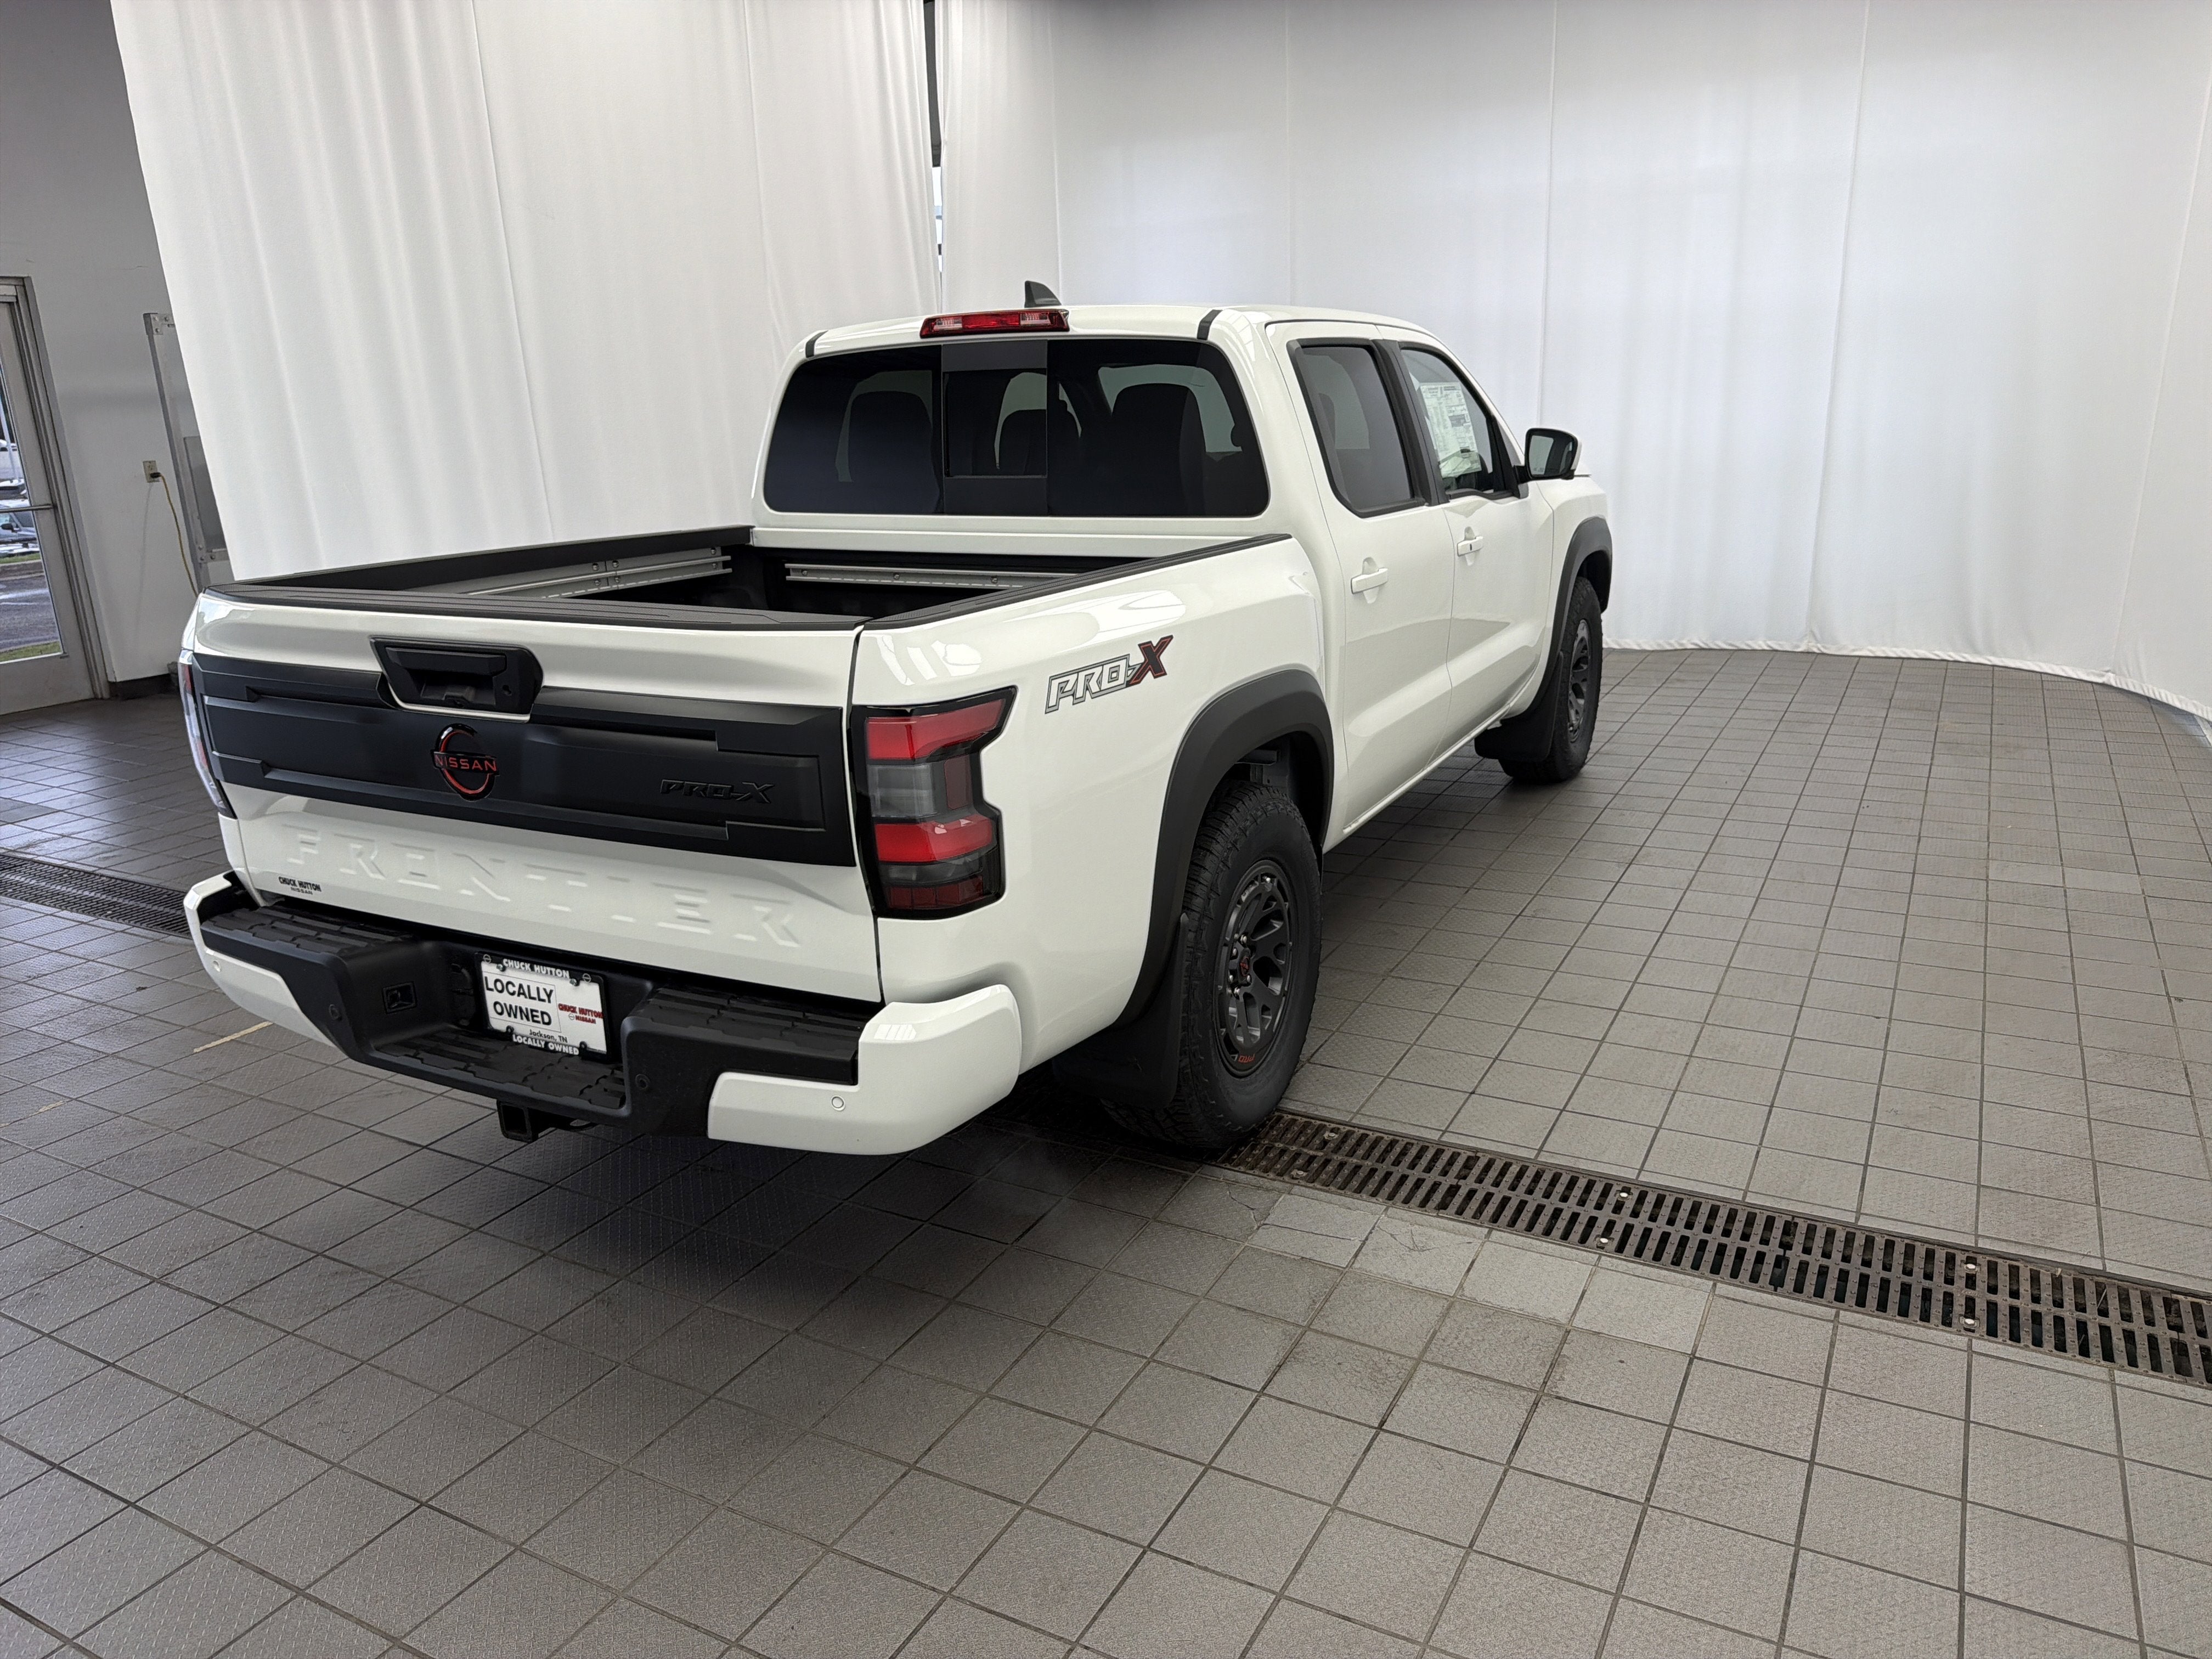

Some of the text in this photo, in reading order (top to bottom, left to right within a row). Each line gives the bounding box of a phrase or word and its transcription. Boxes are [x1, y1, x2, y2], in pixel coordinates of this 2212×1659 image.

[434, 754, 497, 771] NISSAN
[278, 876, 321, 892] CHUCK HUTTON
[281, 823, 801, 947] FRONTIER
[290, 887, 313, 895] NISSAN
[503, 958, 570, 979] CHUCK HUTTON
[484, 976, 554, 1003] LOCALLY
[493, 1001, 552, 1026] OWNED
[558, 1003, 604, 1019] CHUCK HUTTON
[512, 1034, 579, 1056] LOCALLY OWNED
[529, 1029, 568, 1043] Jackson, TN
